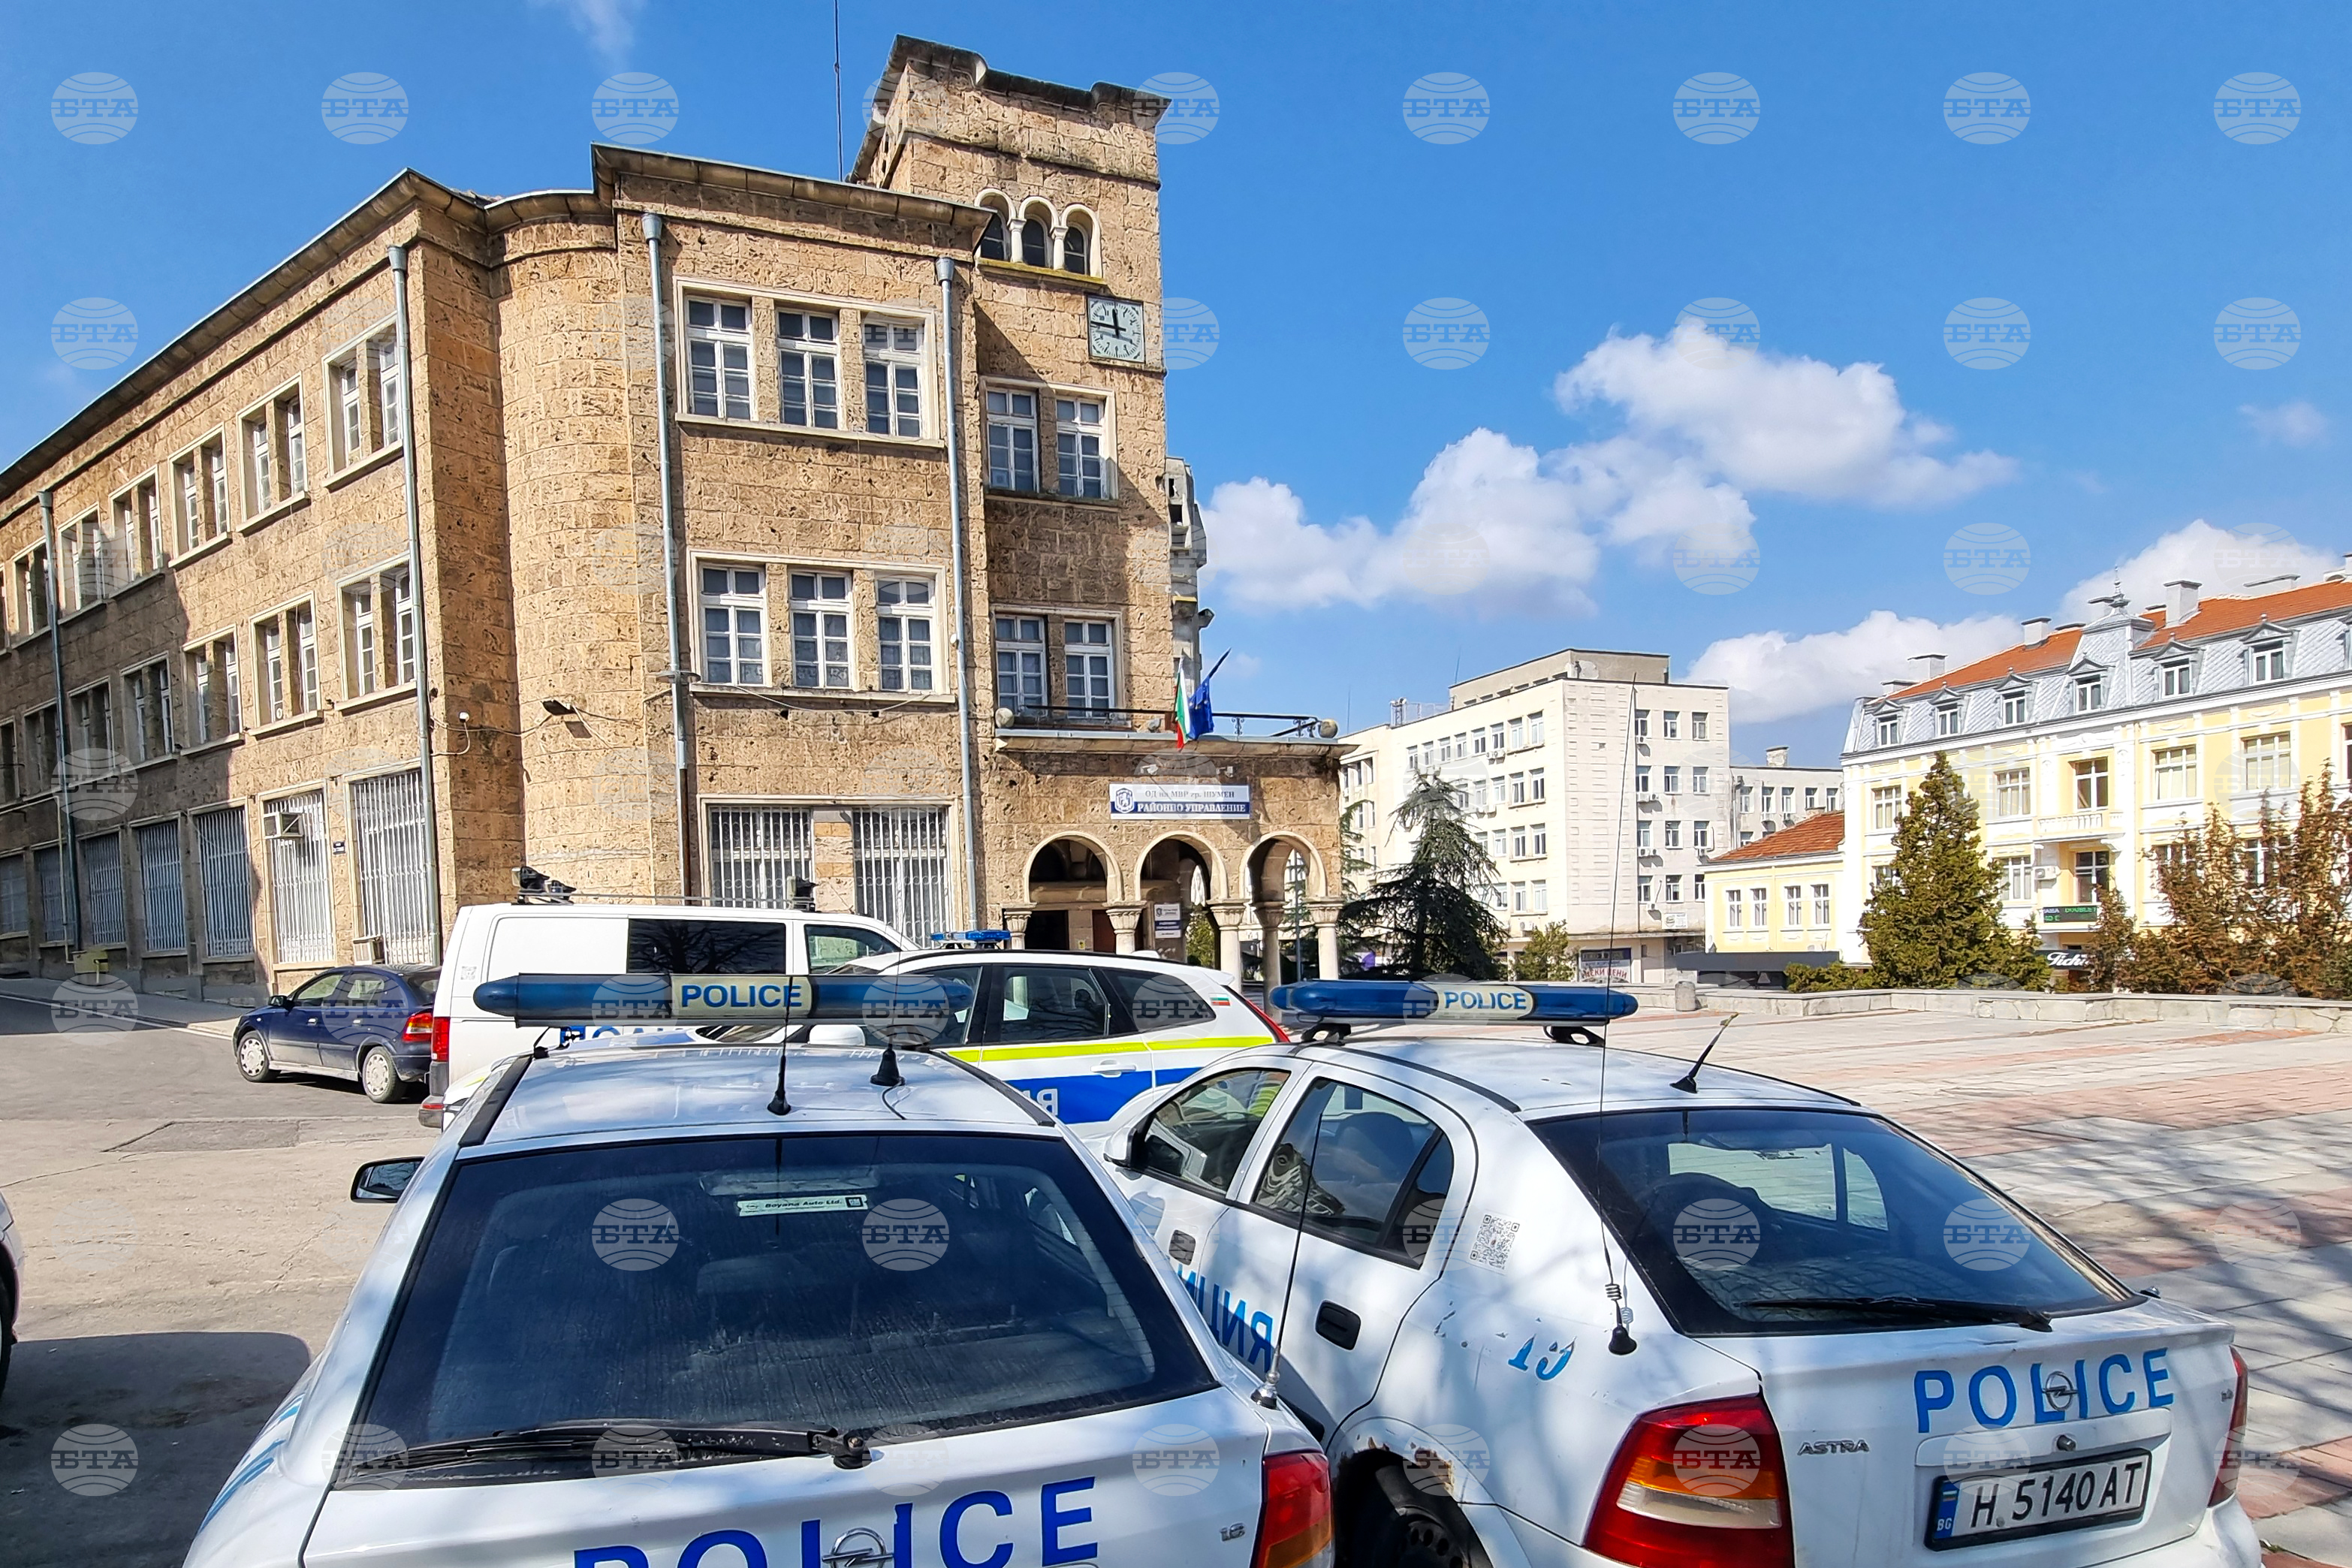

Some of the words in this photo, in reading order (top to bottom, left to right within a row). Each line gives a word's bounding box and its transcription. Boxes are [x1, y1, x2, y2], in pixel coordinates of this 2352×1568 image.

[1145, 790, 1157, 799] ОД
[1171, 790, 1189, 798] МВР
[1204, 790, 1235, 798] ШУМЕН
[1185, 803, 1246, 813] УПРАВЛЕНИЕ
[682, 985, 802, 1008] POLICE
[1443, 991, 1527, 1010] POLICE
[1914, 1347, 2175, 1434] POLICE
[1797, 1439, 1870, 1456] ASTRA
[1937, 1517, 1953, 1531] BG
[2012, 1470, 2096, 1521] 5140
[2099, 1461, 2143, 1508] AT
